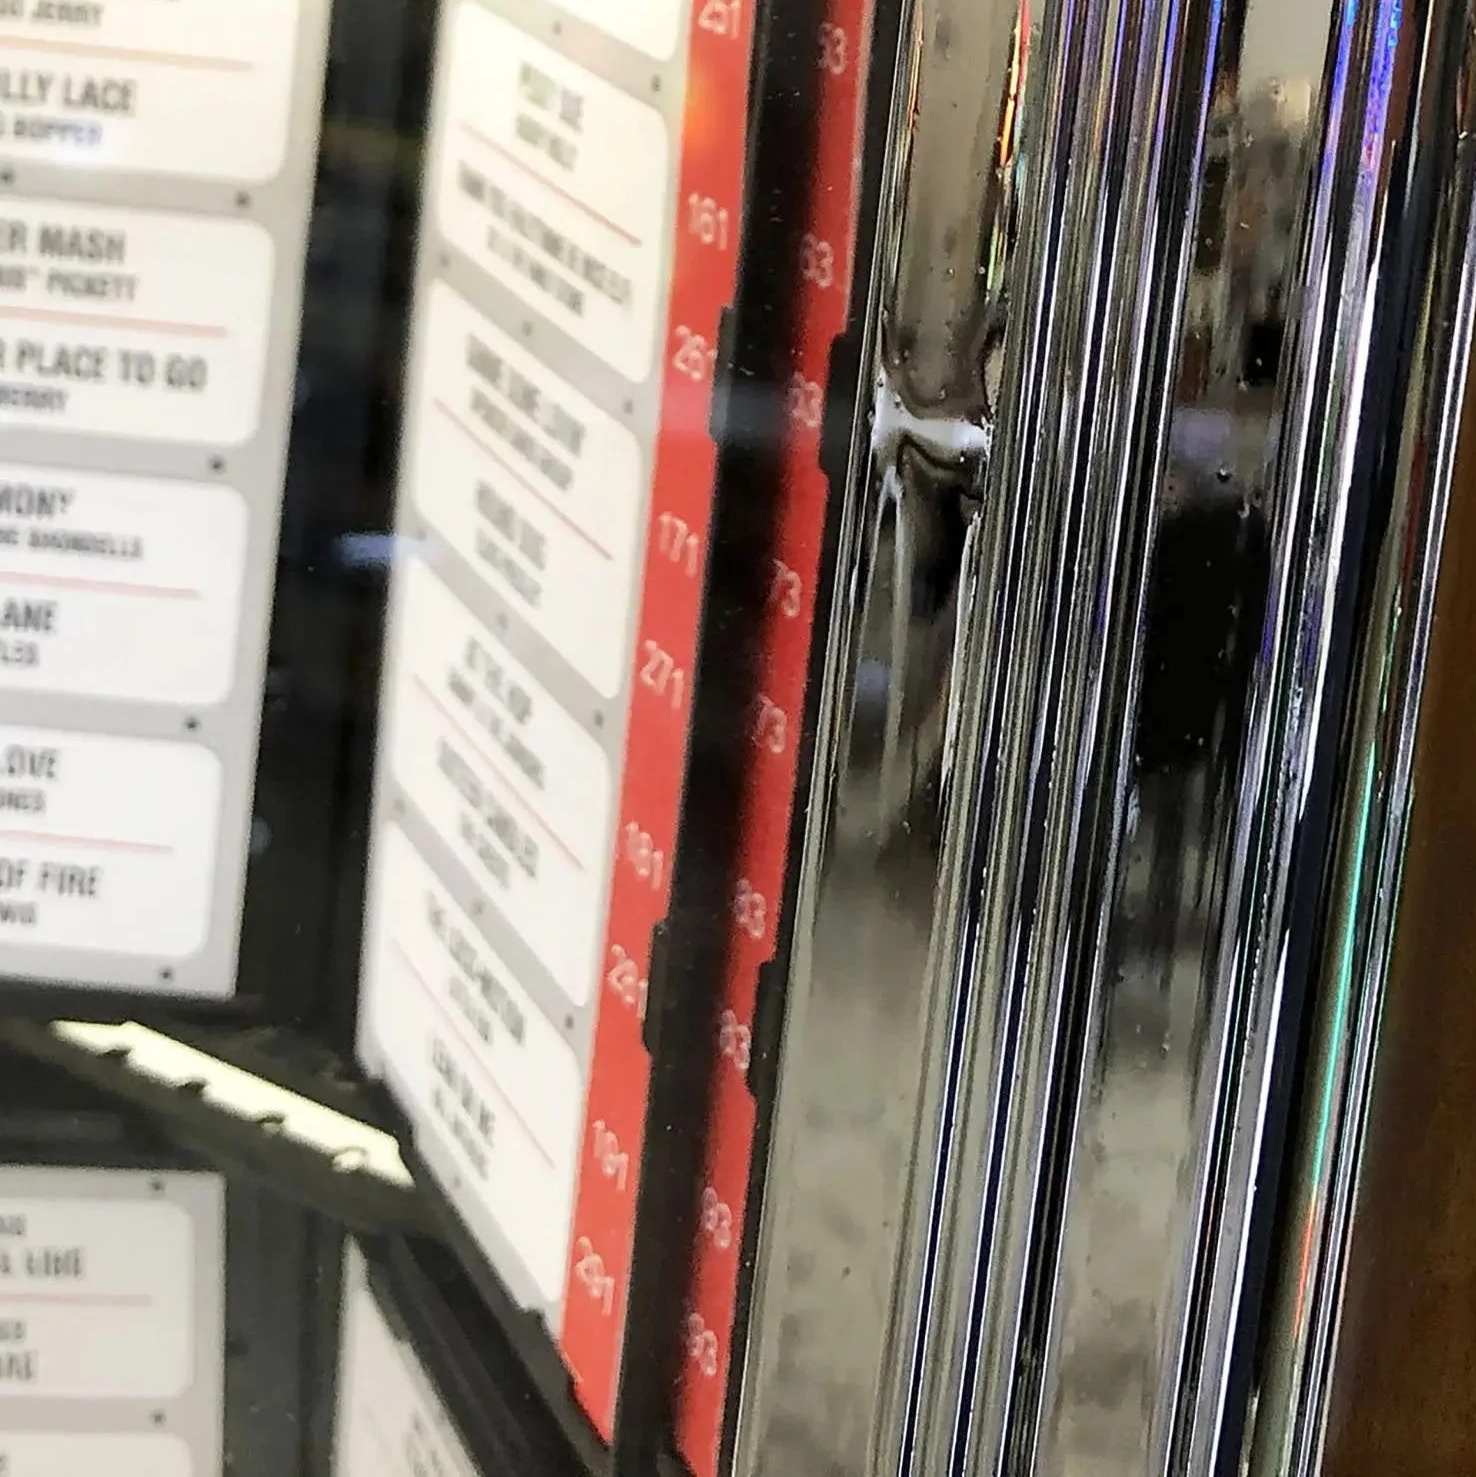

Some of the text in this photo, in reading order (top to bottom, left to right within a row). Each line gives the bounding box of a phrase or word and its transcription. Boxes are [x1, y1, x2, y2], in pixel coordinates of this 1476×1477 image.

[61, 73, 135, 114] LACE
[38, 220, 126, 265] MASH
[15, 337, 107, 383] PLACE
[673, 325, 719, 382] 26
[659, 512, 699, 579] 171
